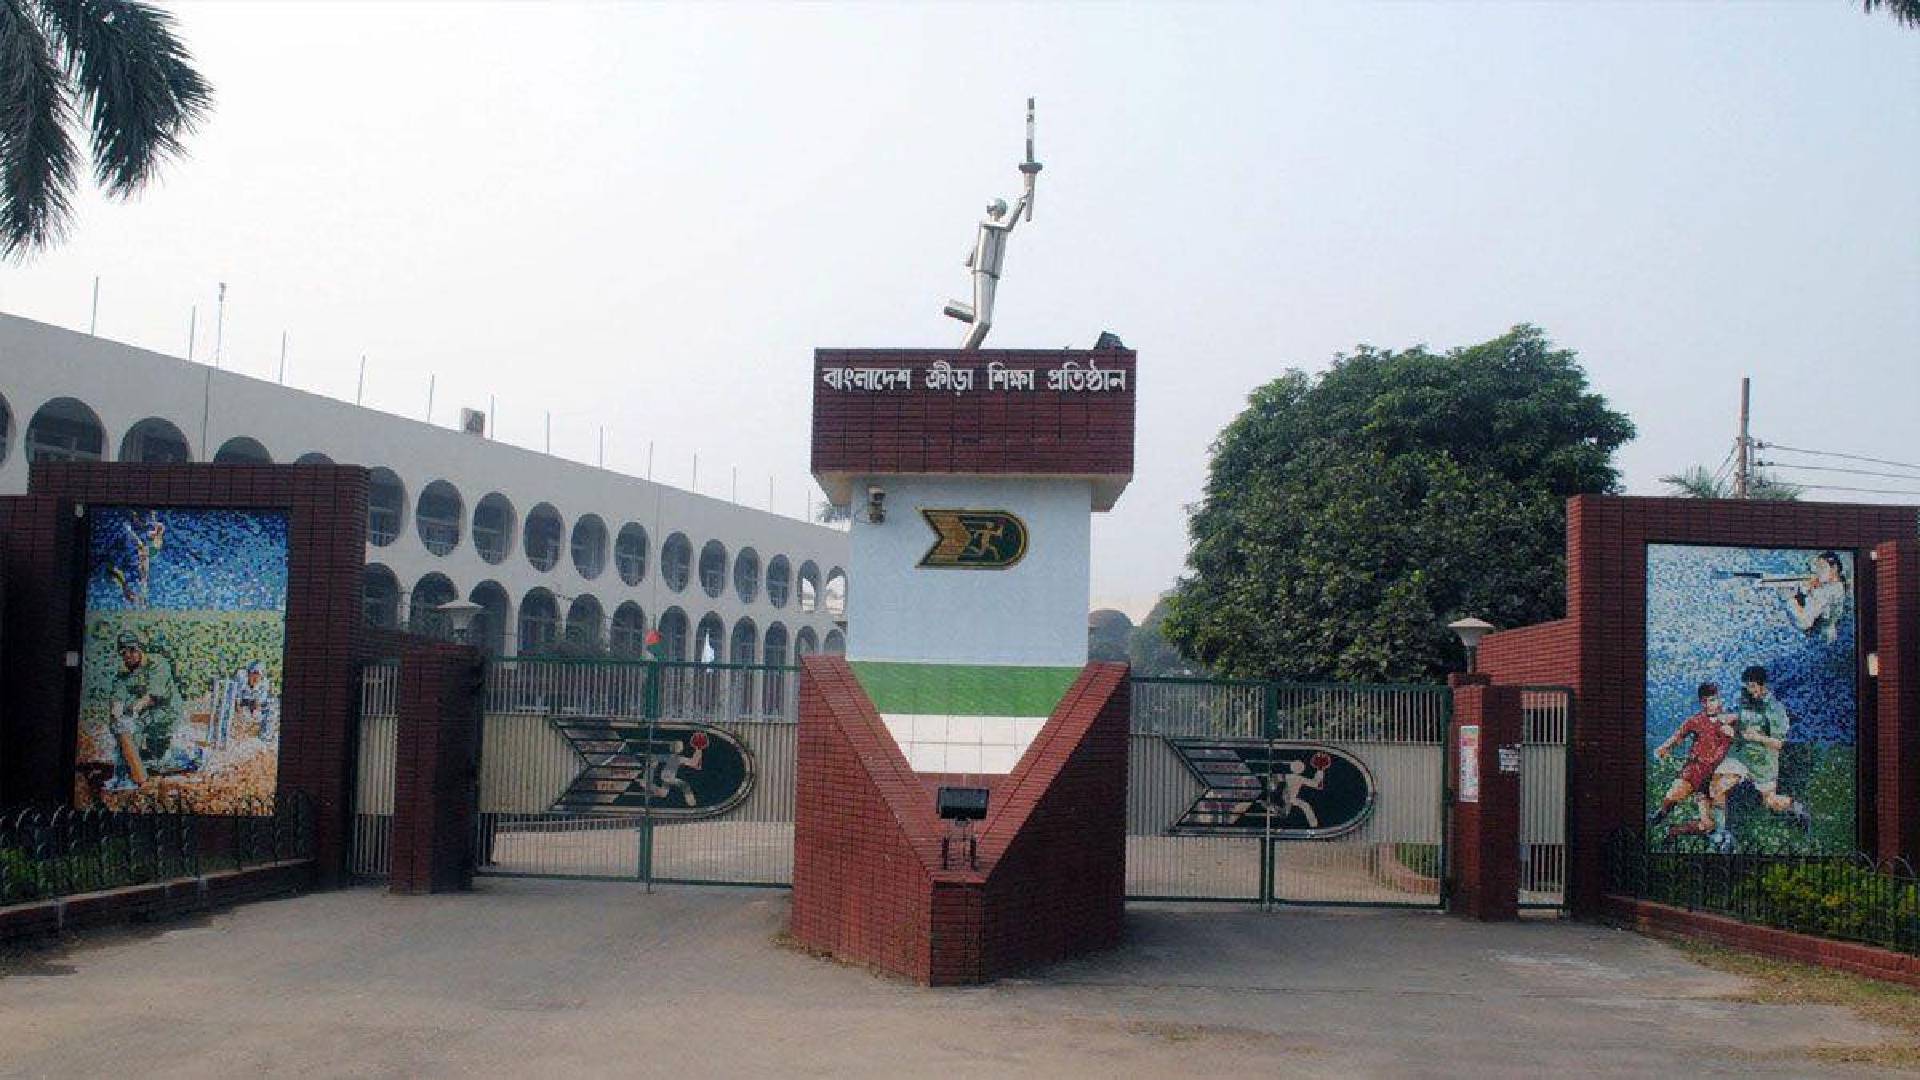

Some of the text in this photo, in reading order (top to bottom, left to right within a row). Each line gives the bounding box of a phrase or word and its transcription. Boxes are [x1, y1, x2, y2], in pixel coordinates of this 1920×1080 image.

[822, 359, 1126, 396] বাংলাদেশ ক্রীড়া শিক্ষা প্রতিষ্ঠান
